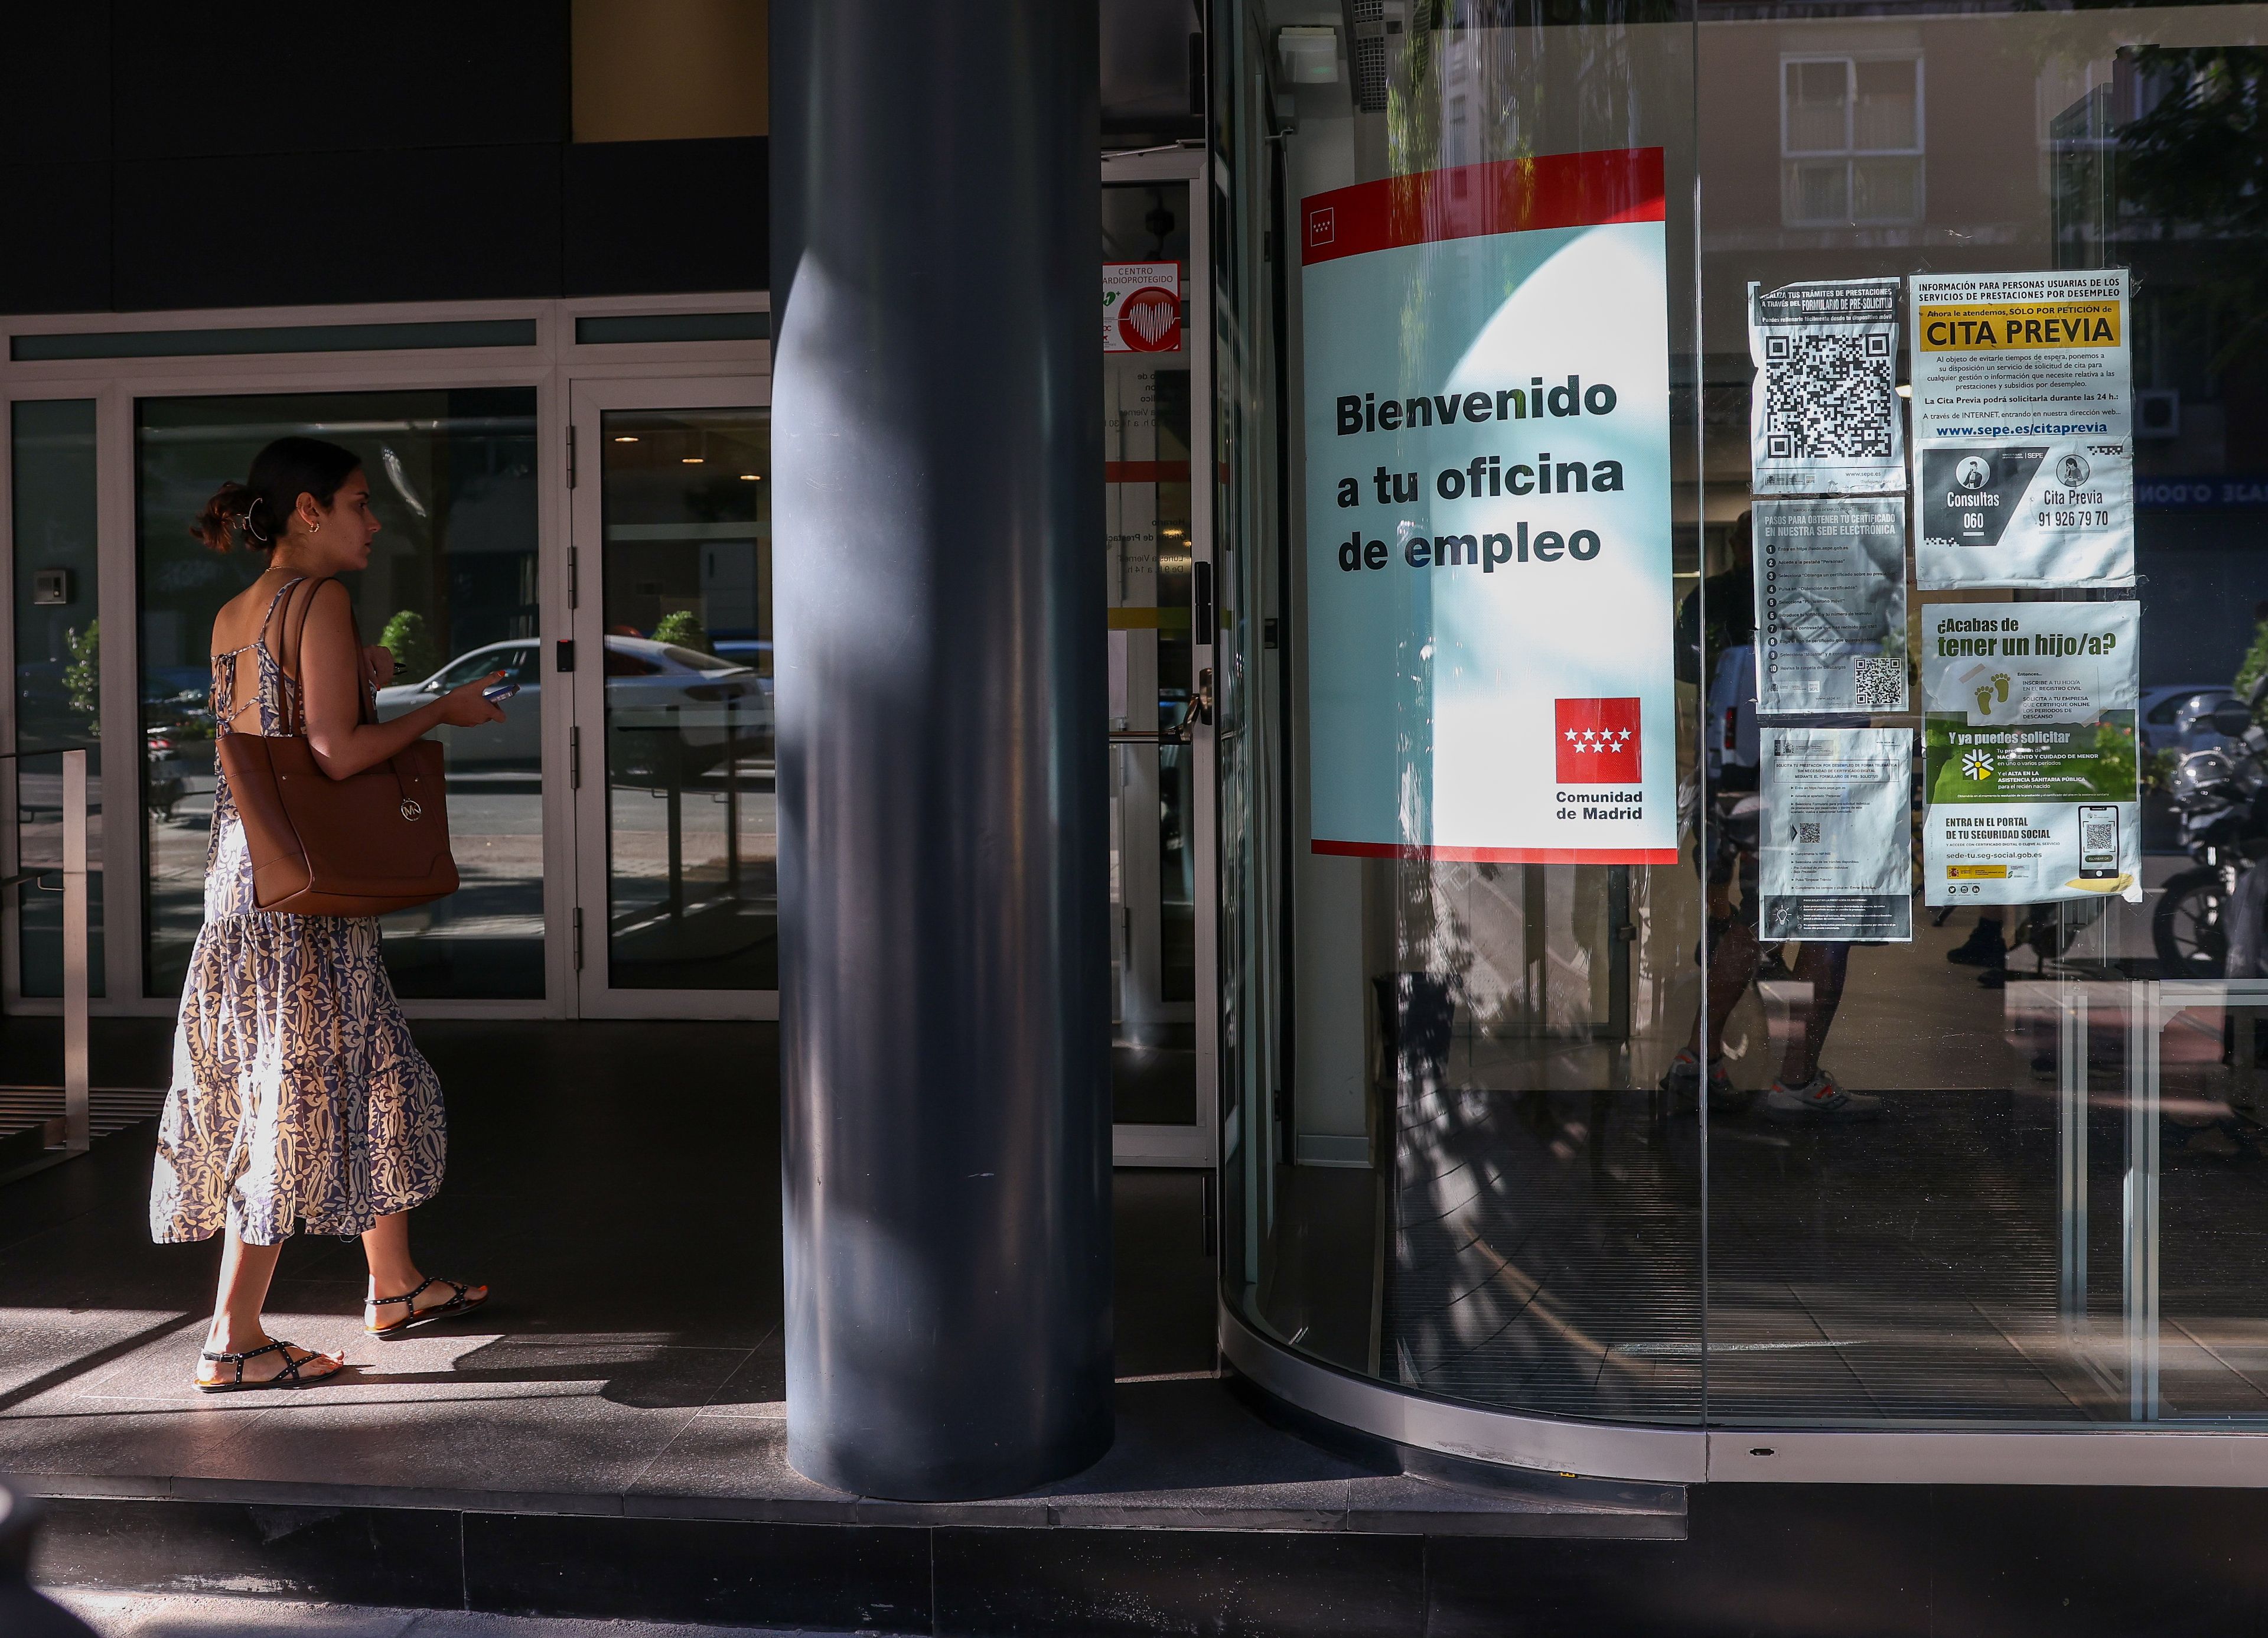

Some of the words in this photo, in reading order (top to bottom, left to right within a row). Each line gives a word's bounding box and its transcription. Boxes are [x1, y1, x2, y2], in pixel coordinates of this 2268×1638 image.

[1103, 275, 1173, 284] ARDIOPROTEGIDO
[1919, 281, 1975, 291] INFORMACIÓN
[2002, 281, 2044, 289] PERSONAS
[2047, 279, 2087, 288] USUARIAS
[1845, 288, 1892, 296] PRESTACIONES
[1919, 292, 1963, 301] SERVICIOS
[1980, 291, 2044, 299] PRESTACIONES
[2067, 288, 2120, 297] DESEMPLEO
[1801, 298, 1839, 311] FORMULARIO
[1840, 298, 1848, 310] DE
[1849, 297, 1892, 310] PRE-SOLICITUD
[1963, 308, 2008, 317] atendemos,
[1927, 321, 1997, 346] CITA
[2006, 317, 2114, 344] PREVIA
[1946, 356, 1967, 364] objeto
[1979, 354, 2003, 363] evitarle
[2005, 354, 2031, 362] tiempos
[2034, 353, 2042, 363] de
[1948, 364, 1984, 373] disposición
[1927, 374, 1957, 383] cualquier
[1958, 373, 1982, 382] gestión
[1955, 383, 1996, 391] prestaciones
[2049, 380, 2087, 389] desempleo.
[1335, 374, 1618, 435] Bienvenido
[1983, 395, 2007, 405] podrá
[1936, 422, 2108, 437] www.sepe.es/citaprevia
[1337, 477, 1359, 509] a
[1373, 465, 1419, 504] tu
[1436, 452, 1625, 503] oficina
[1947, 491, 2000, 507] Consultas
[2044, 490, 2064, 504] Cita
[2069, 490, 2103, 505] Previa
[1764, 516, 1786, 525] PASOS
[1788, 515, 1807, 524] PARA
[1808, 515, 1839, 525] OBTENER
[1840, 514, 1850, 524] TU
[1851, 513, 1896, 524] CERTIFICADO
[1963, 512, 1984, 528] 060
[2038, 512, 2050, 526] 91
[2055, 511, 2074, 526] 926
[2078, 510, 2091, 526] 79
[2095, 510, 2108, 526] 70
[1765, 525, 1775, 536] EN
[1778, 524, 1814, 536] NUESTRA
[1816, 523, 1839, 535] SEDE
[1840, 522, 1896, 535] ELECTRÓNICA
[1338, 530, 1389, 572] de
[1405, 521, 1601, 573] empleo
[1937, 618, 1997, 634] ¿Acabas
[2001, 617, 2019, 631] de
[1937, 636, 1997, 656] tener
[2002, 637, 2030, 656] un
[2035, 633, 2116, 657] hijo/a?
[1948, 732, 1956, 744] Y
[1957, 734, 1972, 745] ya
[1974, 732, 2019, 745] puedes
[2021, 731, 2071, 744] solicitar
[1556, 791, 1643, 802] Comunidad
[1556, 807, 1576, 819] de
[1583, 807, 1643, 819] Madrid
[1946, 818, 1972, 826] ENTRA
[1974, 818, 1984, 826] EN
[1986, 818, 1995, 826] EL
[1997, 817, 2028, 826] PORTAL
[1946, 831, 1956, 839] DE
[1958, 830, 1969, 839] TU
[1971, 829, 2019, 839] SEGURIDAD
[2021, 829, 2051, 839] SOCIAL
